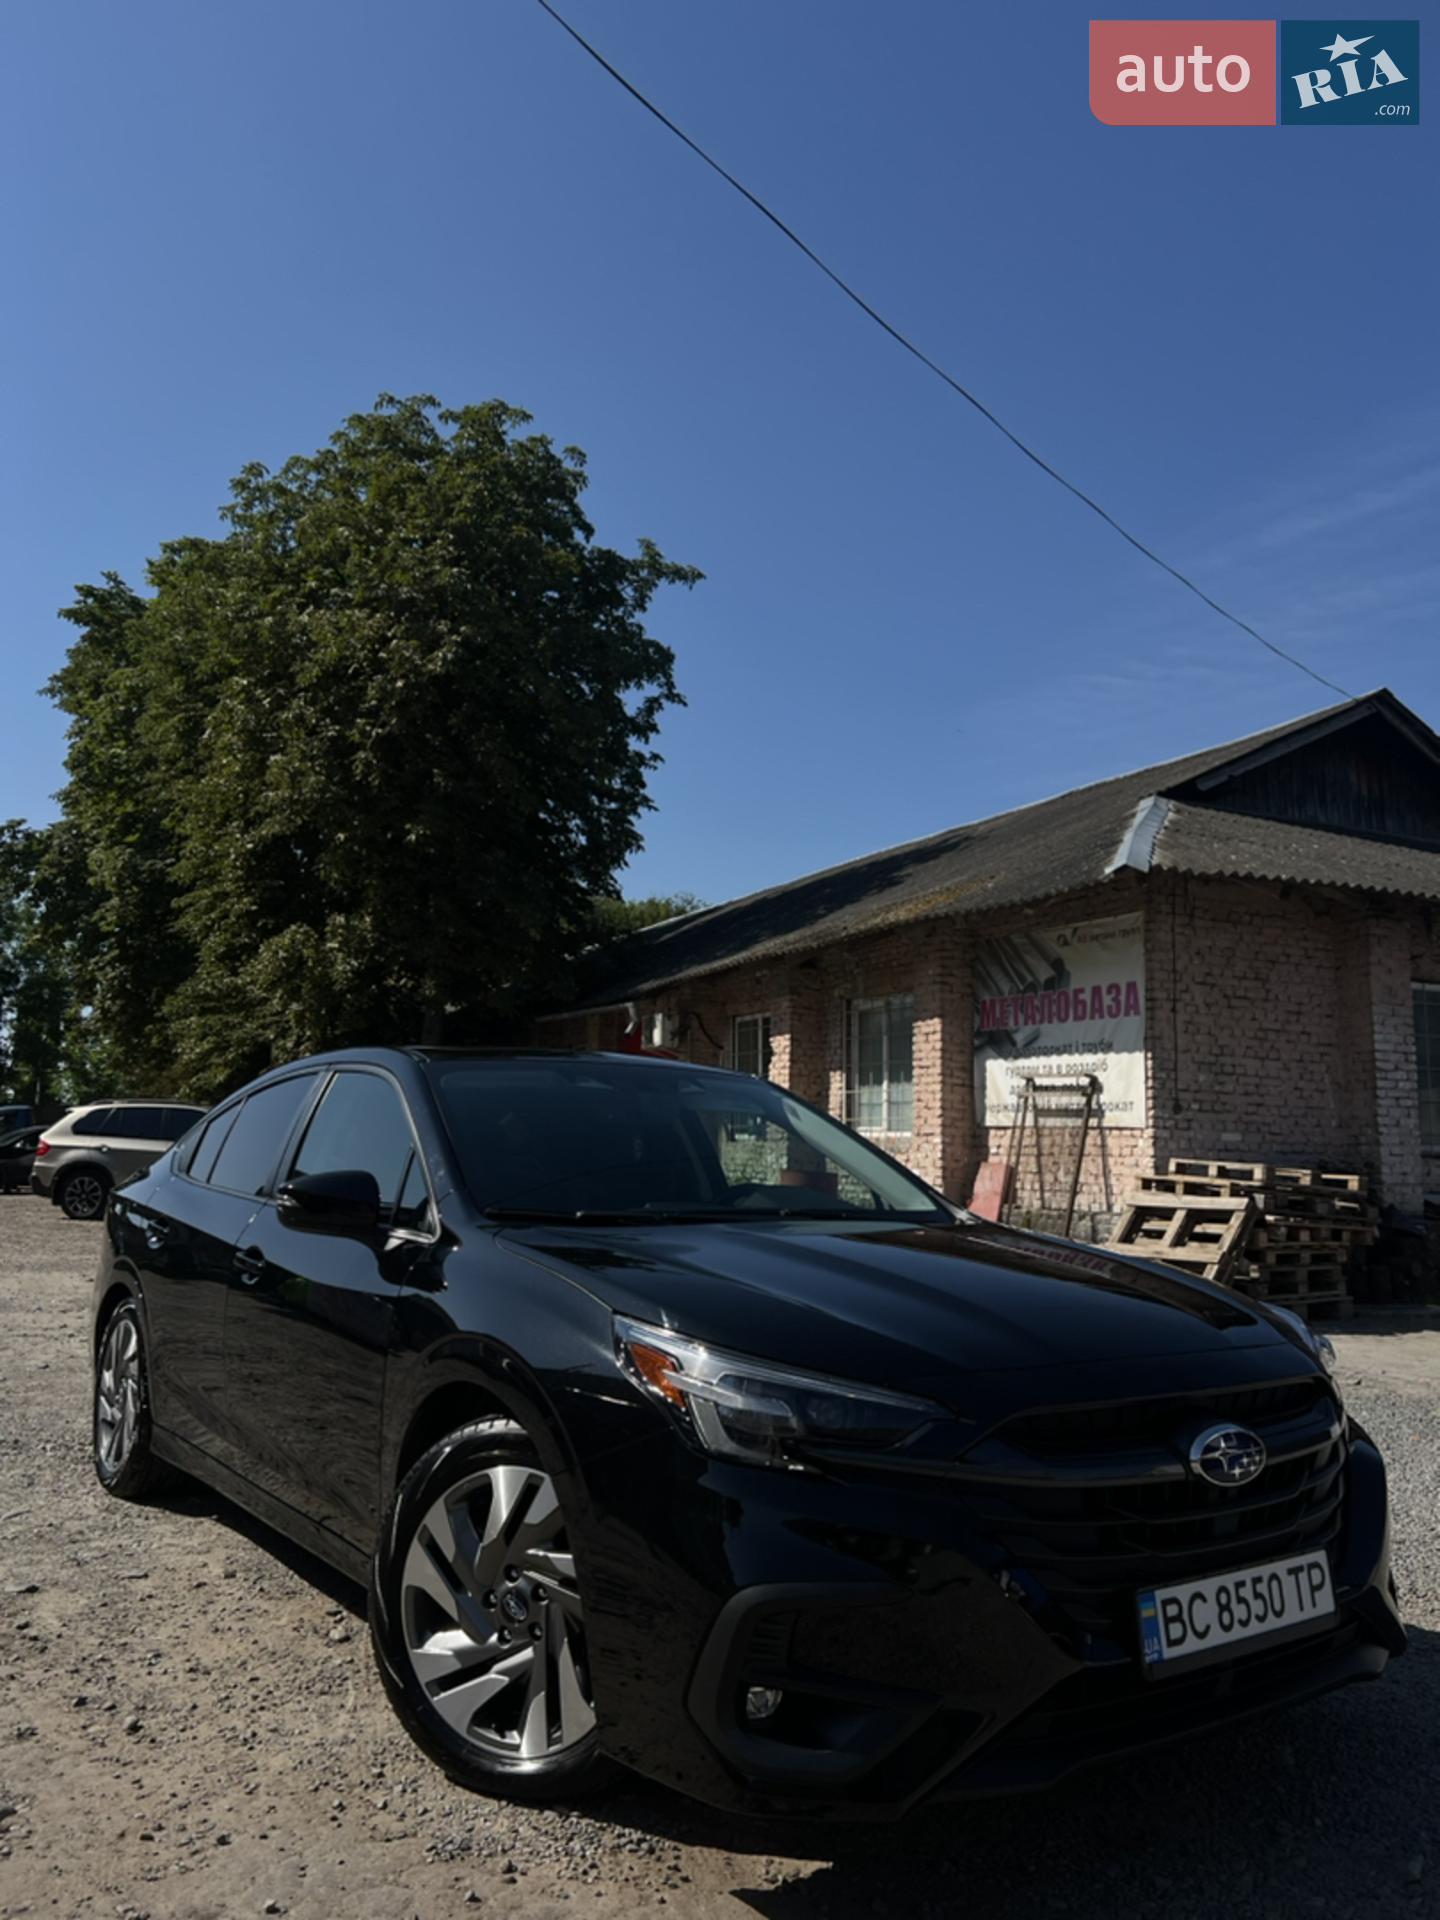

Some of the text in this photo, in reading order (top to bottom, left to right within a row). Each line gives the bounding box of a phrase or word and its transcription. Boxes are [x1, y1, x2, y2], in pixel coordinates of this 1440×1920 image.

[980, 980, 1142, 1031] МЕТАЛОБАЗА
[1081, 1037, 1114, 1054] труби
[1160, 1560, 1327, 1649] BC 8550 TP
[1144, 1636, 1161, 1654] UA
